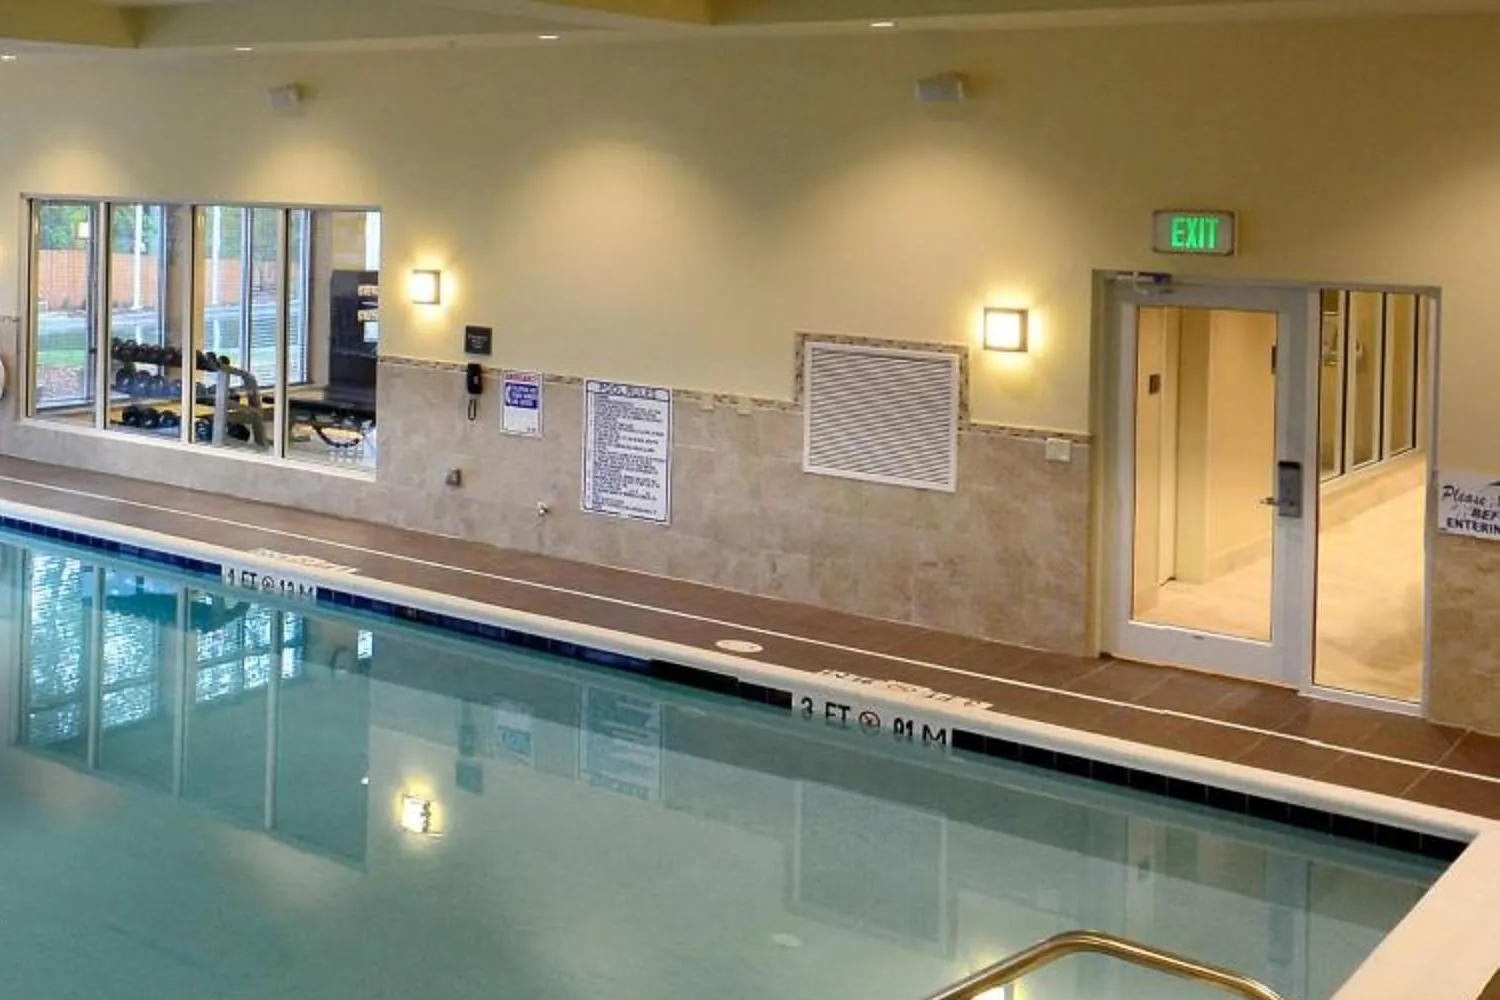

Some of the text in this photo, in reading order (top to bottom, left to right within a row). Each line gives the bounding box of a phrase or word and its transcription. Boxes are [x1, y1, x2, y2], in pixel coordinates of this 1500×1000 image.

[1171, 217, 1219, 249] EXIT
[1442, 484, 1487, 506] Please
[242, 571, 258, 590] FT
[825, 702, 851, 722] FT
[922, 724, 947, 745] M
